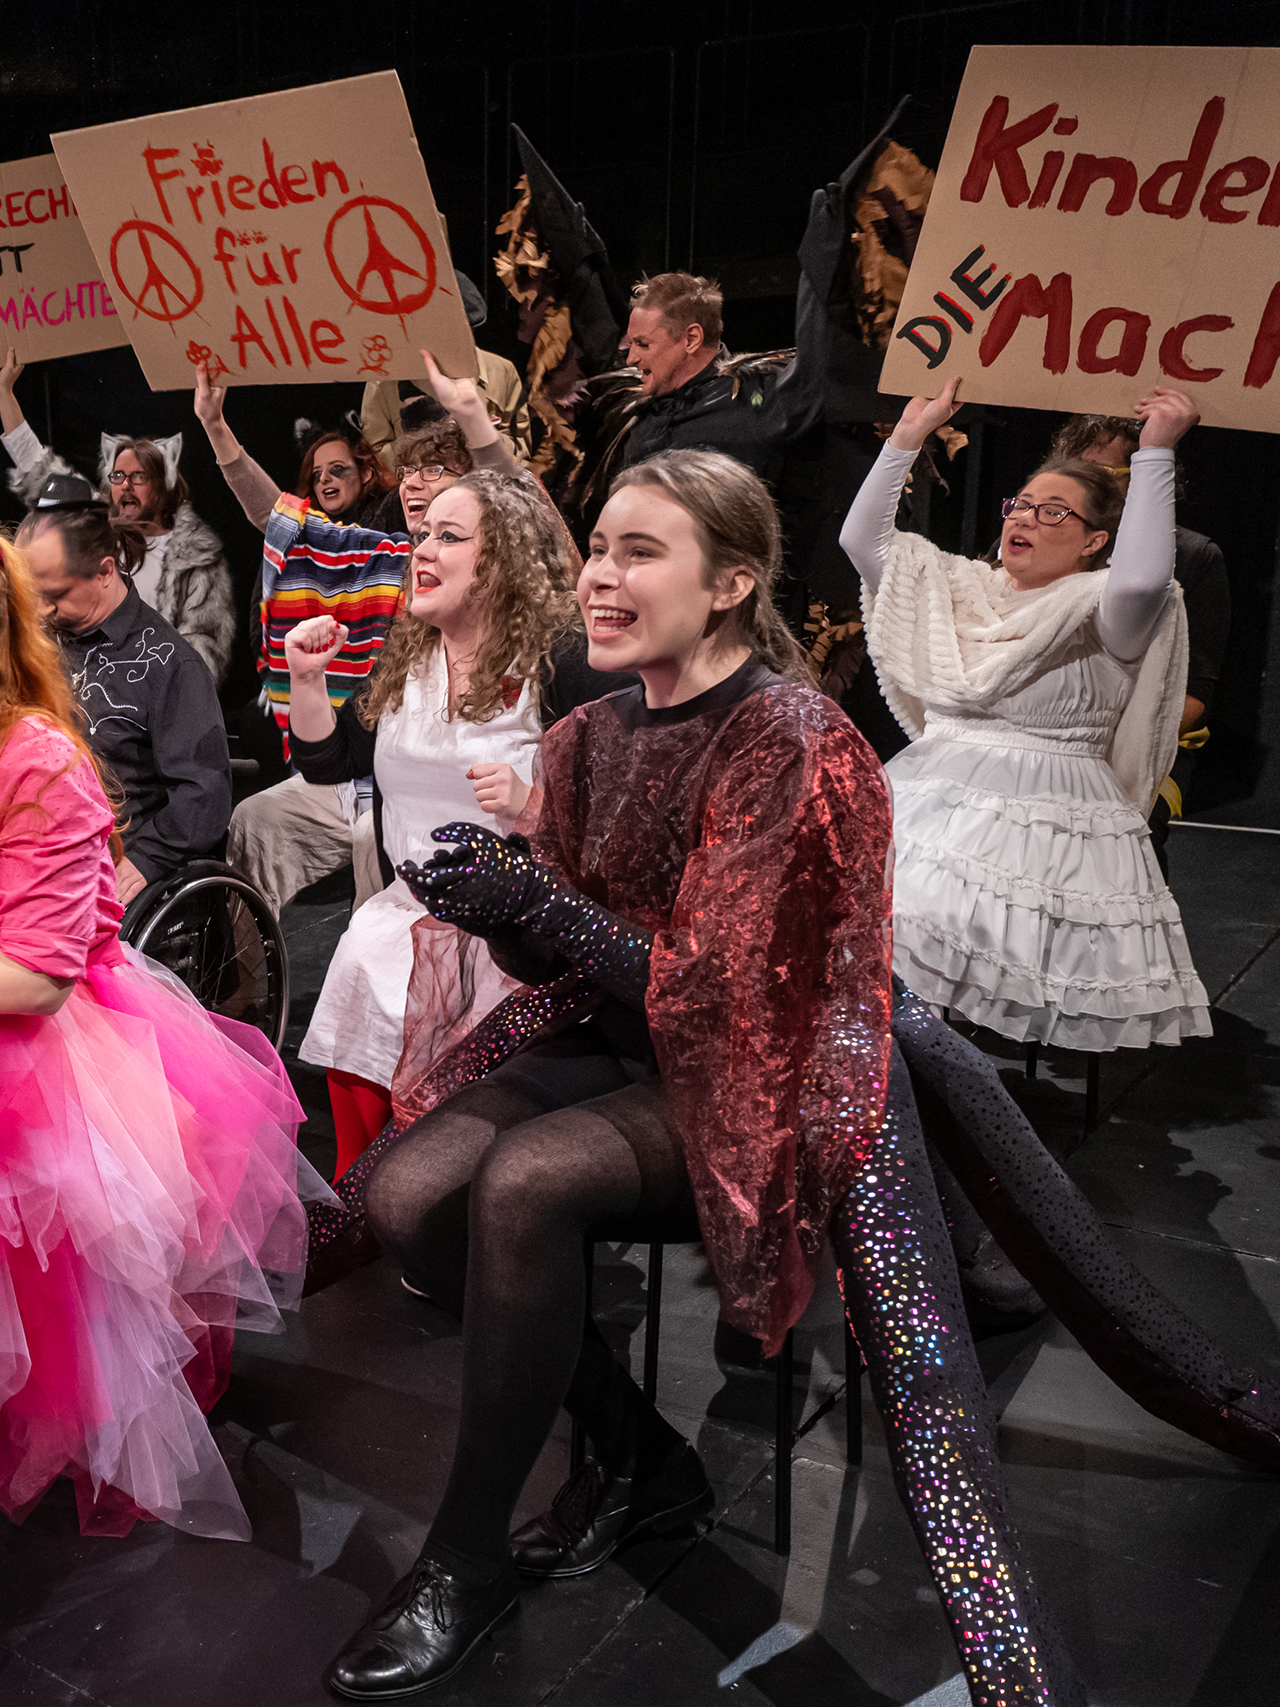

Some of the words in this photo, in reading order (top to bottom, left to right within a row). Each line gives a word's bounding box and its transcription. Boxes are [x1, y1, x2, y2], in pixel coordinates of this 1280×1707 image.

[141, 136, 350, 226] Frieden
[213, 226, 302, 295] für
[230, 296, 349, 370] Alle
[895, 243, 1013, 370] DIE
